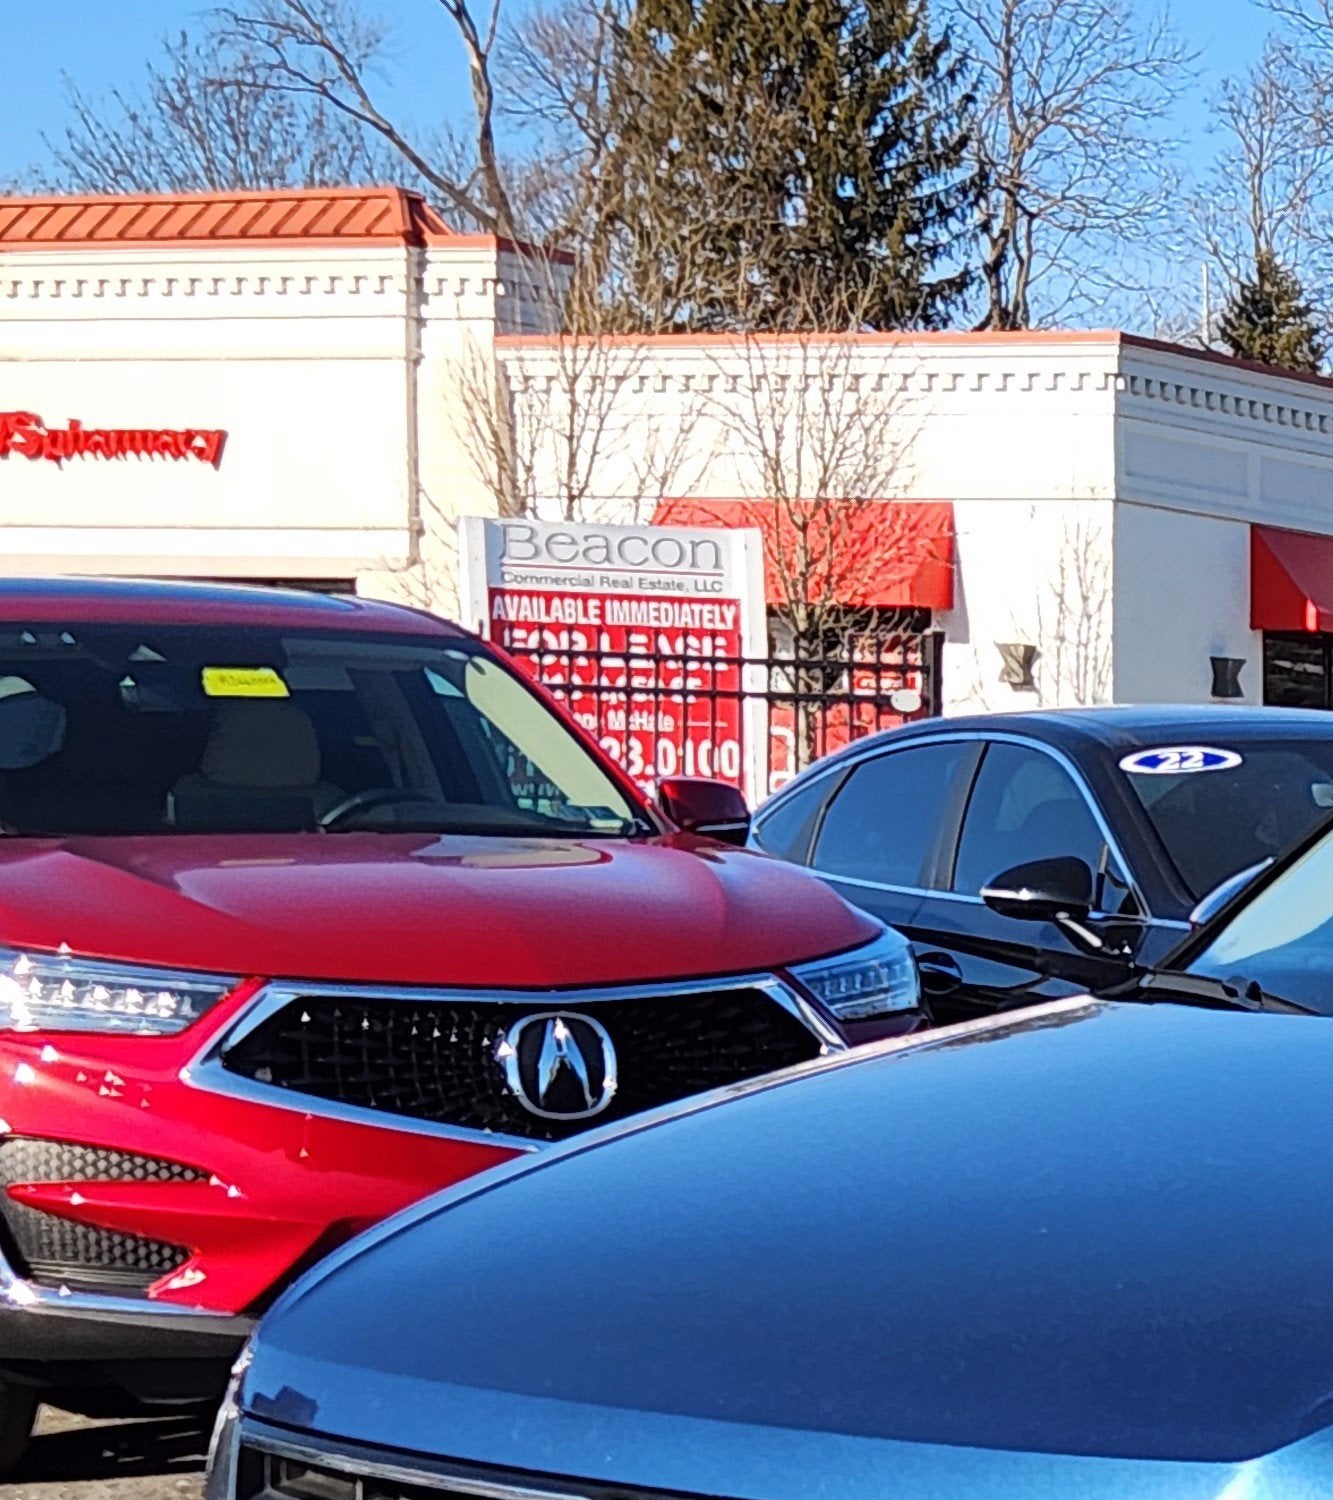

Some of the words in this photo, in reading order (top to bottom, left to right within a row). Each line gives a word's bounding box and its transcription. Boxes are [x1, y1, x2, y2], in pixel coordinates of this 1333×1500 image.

[501, 523, 723, 569] Beacon
[501, 571, 595, 586] Commercial
[599, 576, 634, 589] Real
[638, 578, 689, 592] Estate,
[694, 579, 724, 592] LLC
[493, 594, 600, 624] AVAILABLE
[605, 599, 736, 630] IMMEDIATELY
[600, 631, 729, 671] LEASE
[1155, 751, 1205, 770] 22
